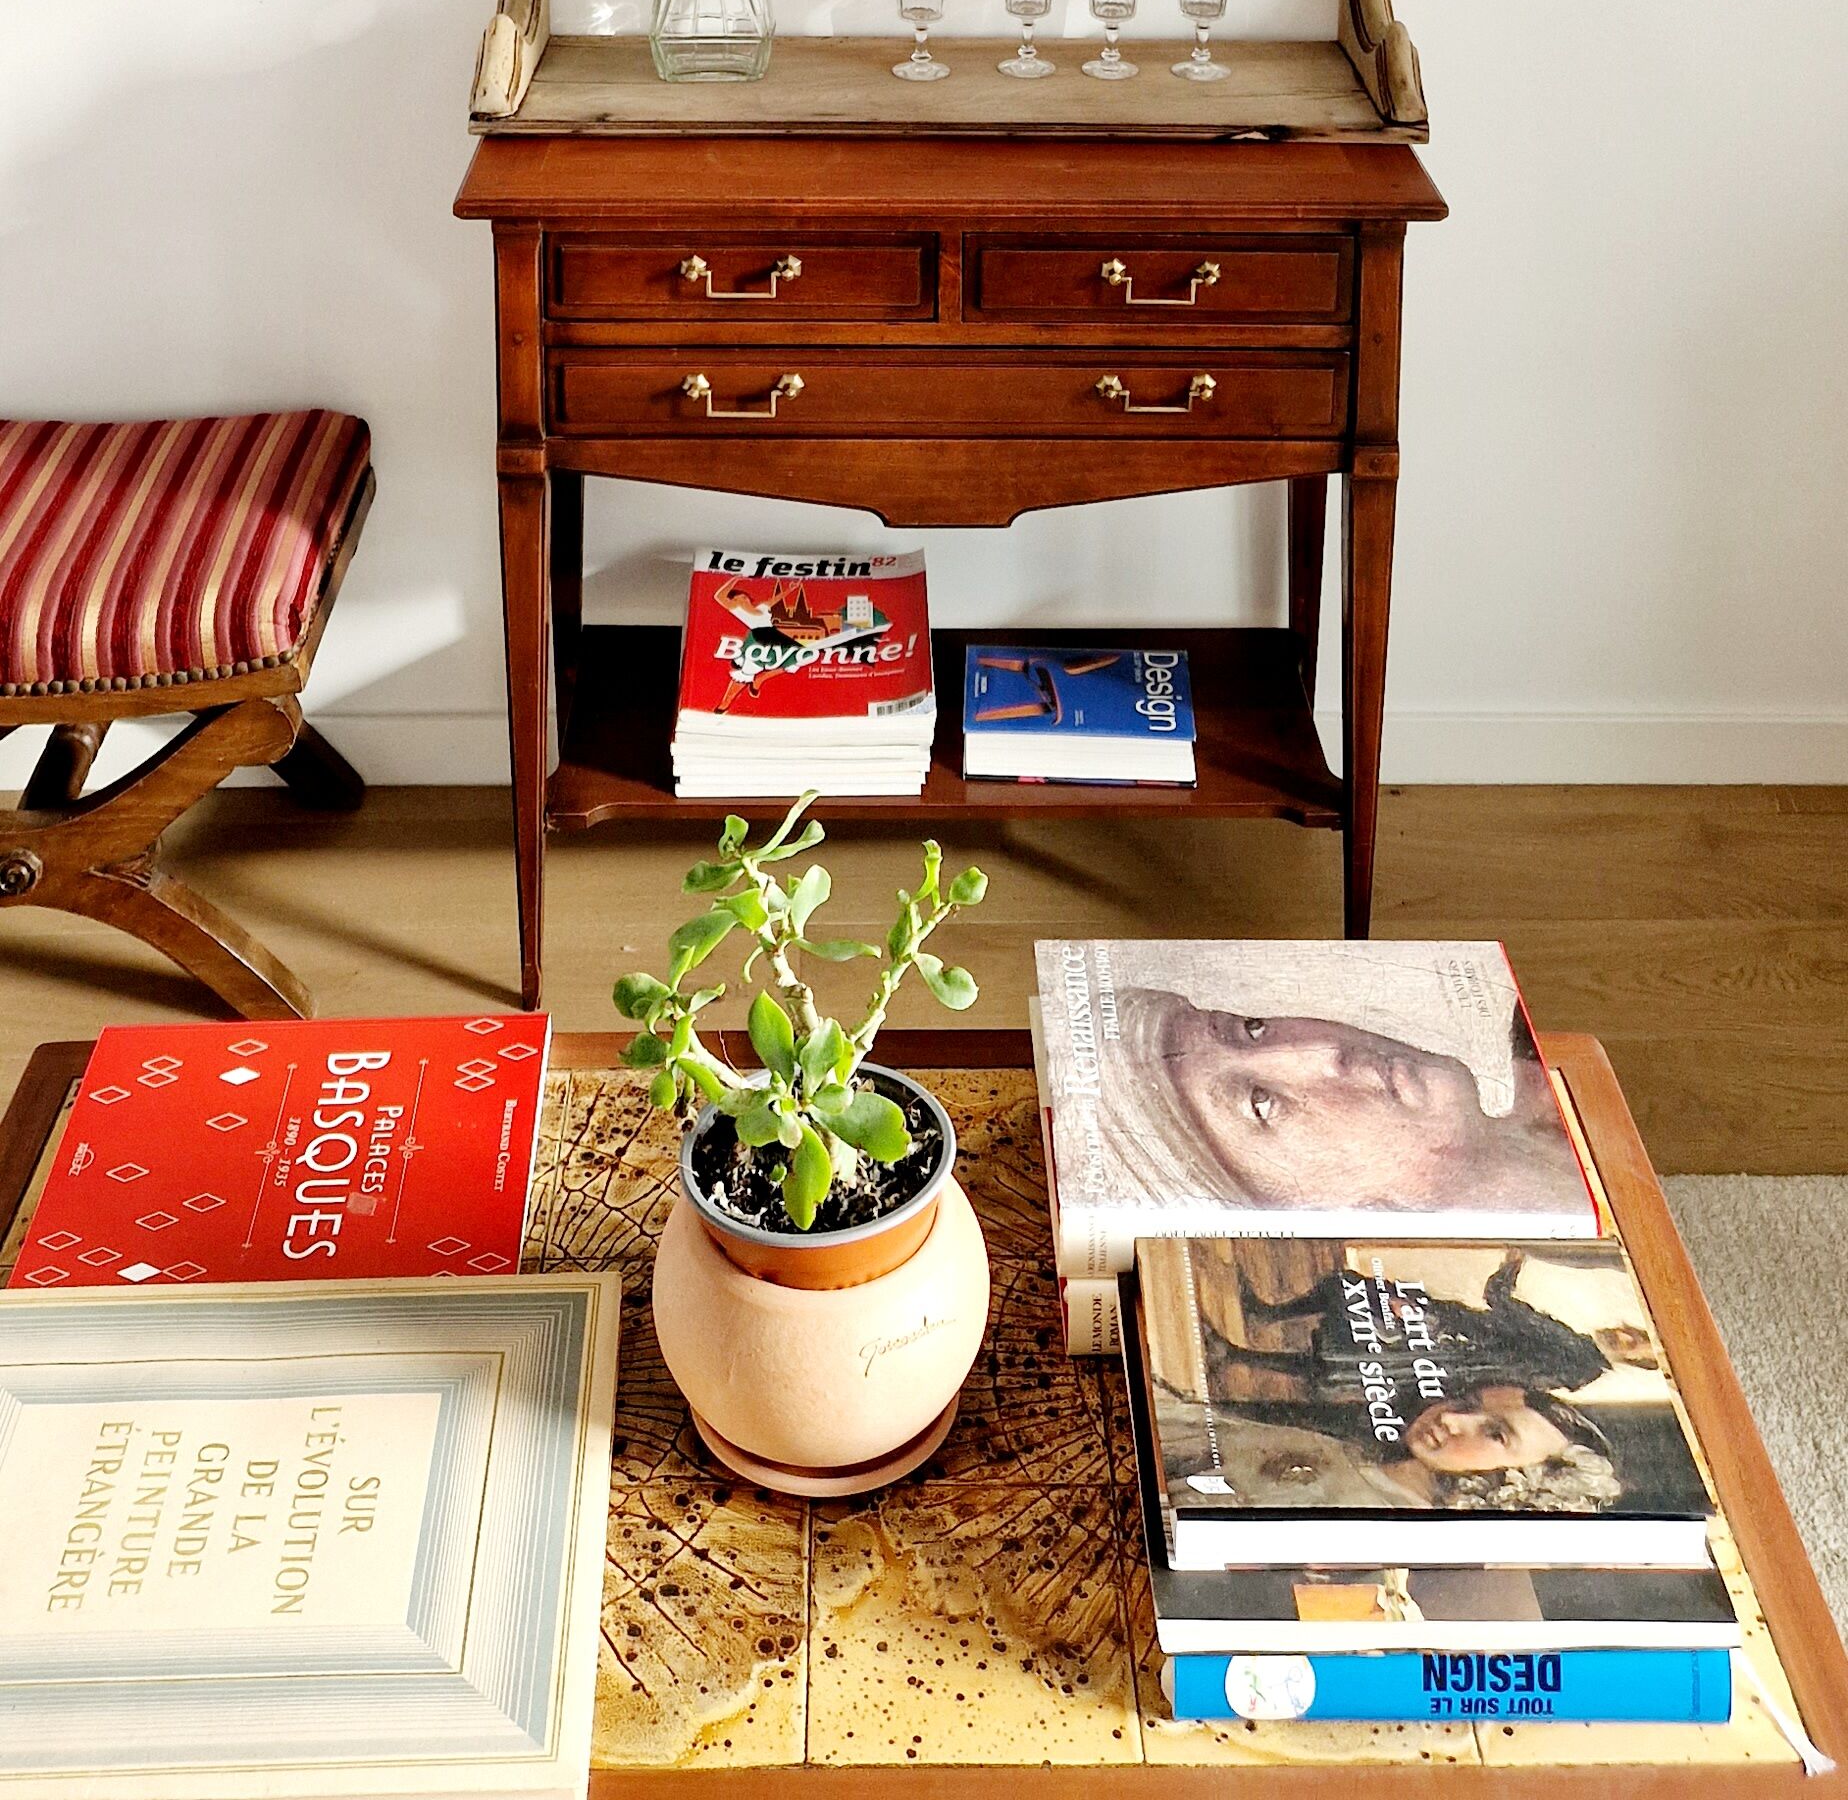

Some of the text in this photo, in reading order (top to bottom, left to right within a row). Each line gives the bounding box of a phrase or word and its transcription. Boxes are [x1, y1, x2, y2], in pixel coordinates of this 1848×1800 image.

[708, 551, 745, 572] le
[749, 557, 872, 579] festin
[714, 633, 918, 673] Bayonne!
[1135, 651, 1183, 733] Design
[1062, 946, 1101, 1098] Renaissance
[283, 1051, 392, 1260] BASQUES
[284, 1117, 302, 1146] 1890
[361, 1105, 404, 1193] PALACES
[274, 1158, 292, 1188] 1935
[1371, 1257, 1387, 1292] Olivier
[1091, 1293, 1102, 1339] MONDE
[1109, 1304, 1119, 1347] ROMAN
[1395, 1280, 1449, 1400] L'art du
[1359, 1361, 1407, 1443] siècle
[47, 1420, 142, 1613] ÉTRANGÈRE
[107, 1430, 182, 1598] PEINTURE
[166, 1443, 230, 1578] GRANDE
[228, 1459, 280, 1554] DE LA
[270, 1406, 347, 1614] L'ÉVOLUTION
[337, 1476, 381, 1536] SUR
[1423, 1654, 1561, 1692] DESIGN
[1430, 1697, 1554, 1715] TOUT SUR LE
